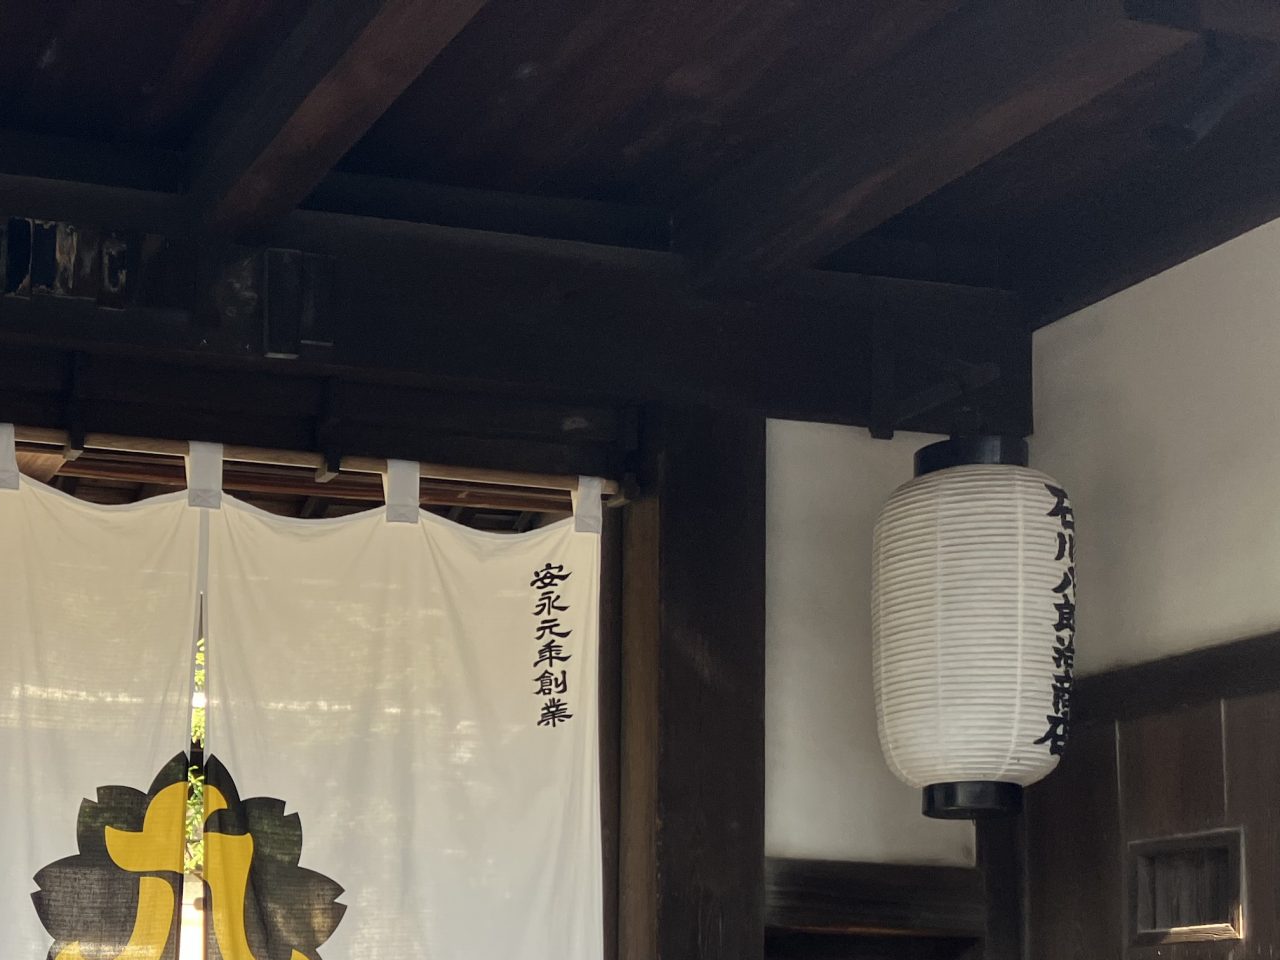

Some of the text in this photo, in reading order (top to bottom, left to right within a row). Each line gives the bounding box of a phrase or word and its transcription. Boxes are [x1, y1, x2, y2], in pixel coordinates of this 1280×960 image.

[529, 562, 574, 728] 安永元年創業
